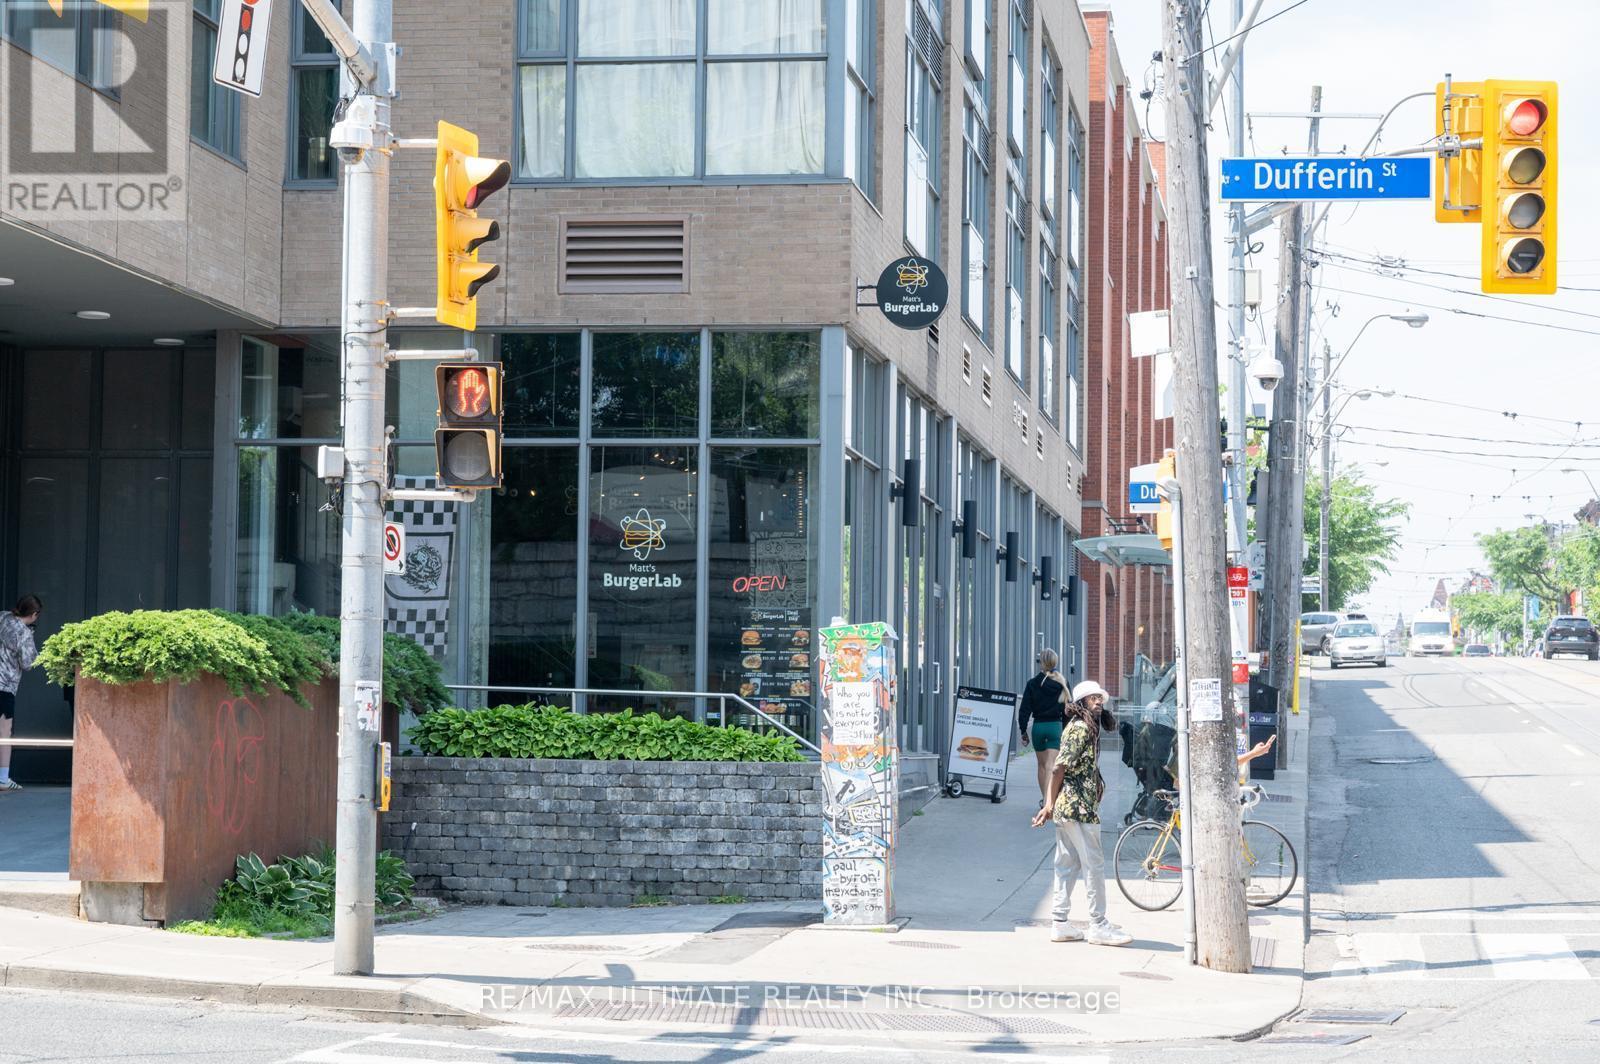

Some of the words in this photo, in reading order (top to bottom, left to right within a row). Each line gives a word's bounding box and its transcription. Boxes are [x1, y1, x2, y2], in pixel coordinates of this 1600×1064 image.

[1254, 161, 1373, 190] Dufferin
[1382, 162, 1397, 177] St
[884, 302, 939, 315] BurgerLab
[629, 564, 656, 572] Matt's
[603, 573, 682, 590] BurgerLab
[732, 575, 787, 593] OPEN
[836, 686, 853, 698] Who
[856, 690, 871, 702] you
[843, 701, 860, 709] are
[846, 709, 860, 718] not
[833, 859, 856, 875] paul
